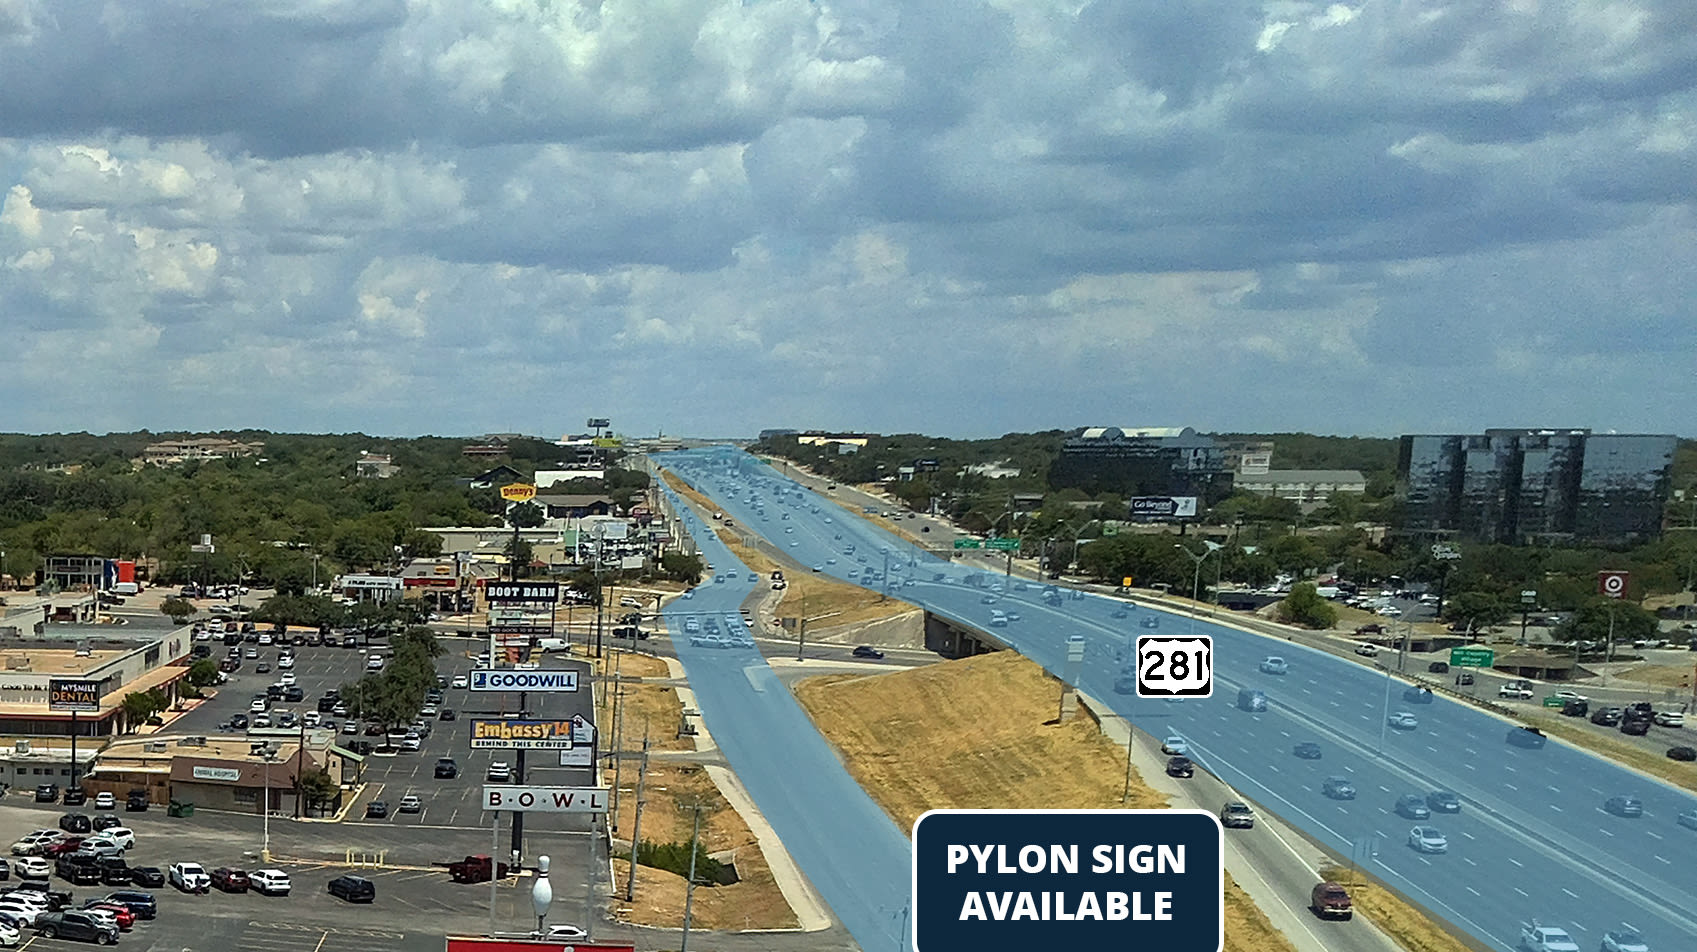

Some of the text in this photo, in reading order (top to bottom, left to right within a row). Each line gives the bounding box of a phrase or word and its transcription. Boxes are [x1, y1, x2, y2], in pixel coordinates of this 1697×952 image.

[503, 487, 534, 497] Denny's
[488, 586, 555, 597] BOOT BARN
[490, 674, 575, 688] GOODWILL
[61, 684, 97, 692] MYSMILE
[52, 692, 96, 702] DENTAL
[474, 721, 553, 739] Embassy
[512, 740, 532, 748] THIS
